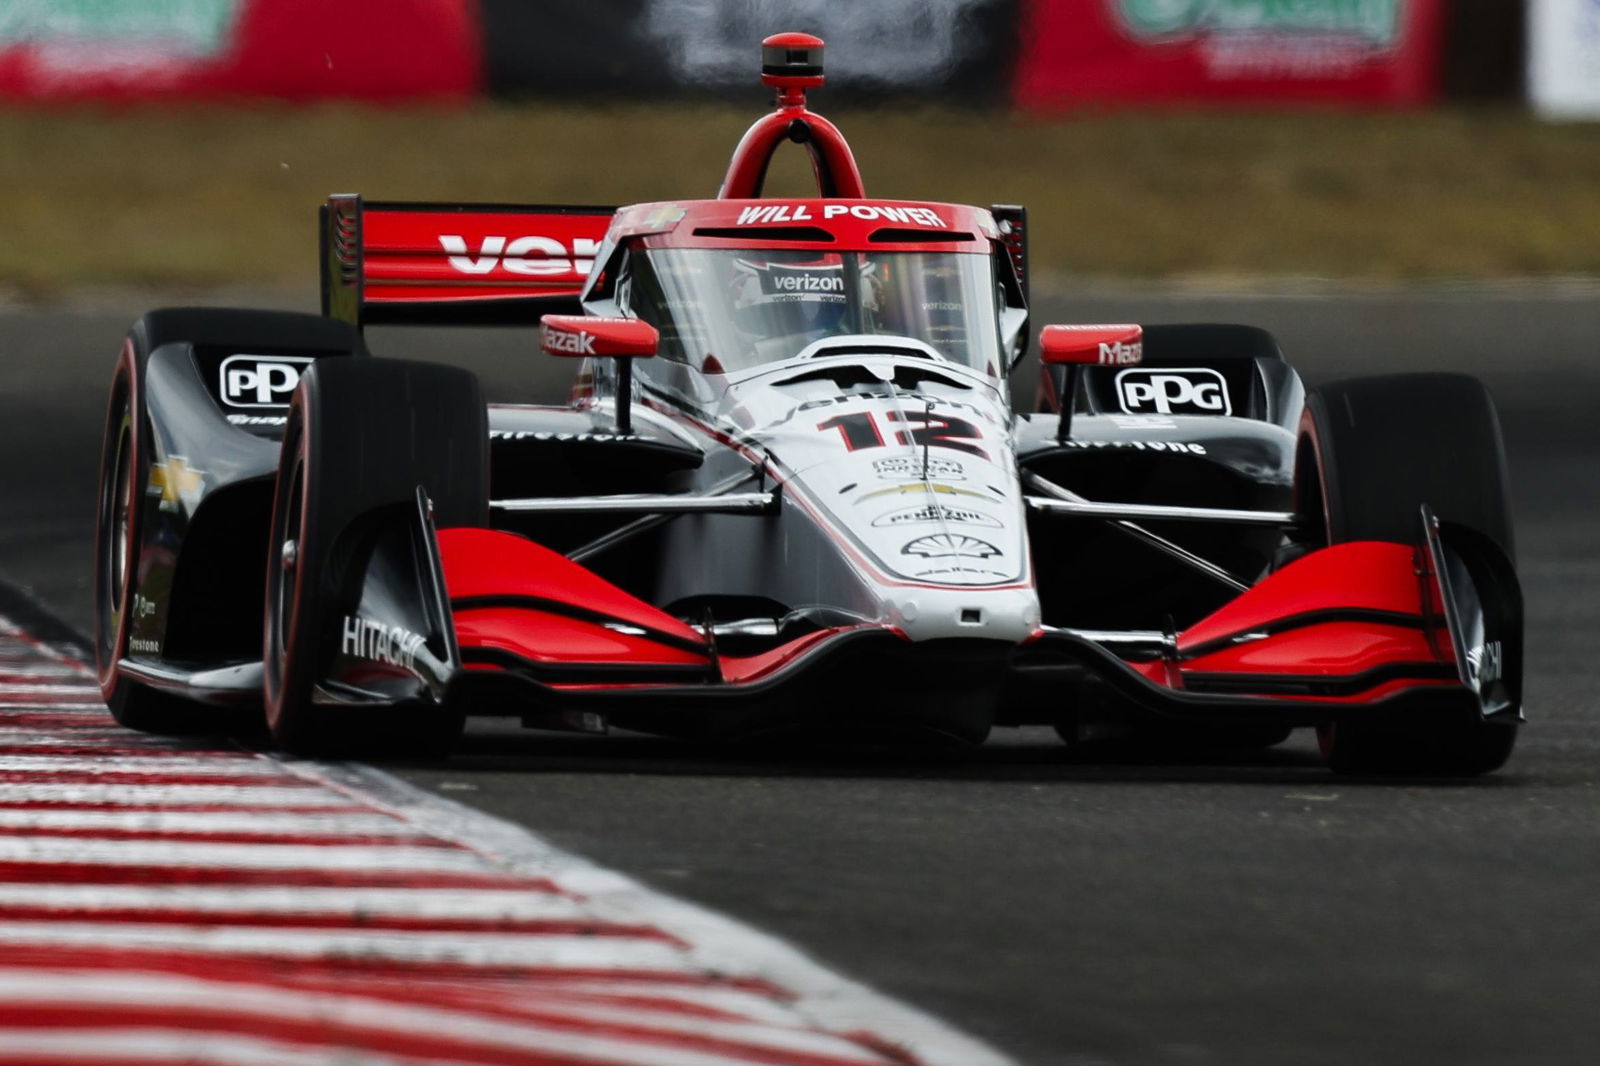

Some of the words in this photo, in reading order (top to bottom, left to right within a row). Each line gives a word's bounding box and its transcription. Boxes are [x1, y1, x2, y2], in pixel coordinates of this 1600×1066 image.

[737, 205, 812, 225] WILL
[824, 205, 948, 228] POWER
[774, 273, 844, 291] verizon
[228, 362, 300, 403] PP
[1124, 375, 1223, 414] PPG
[816, 411, 992, 463] 12
